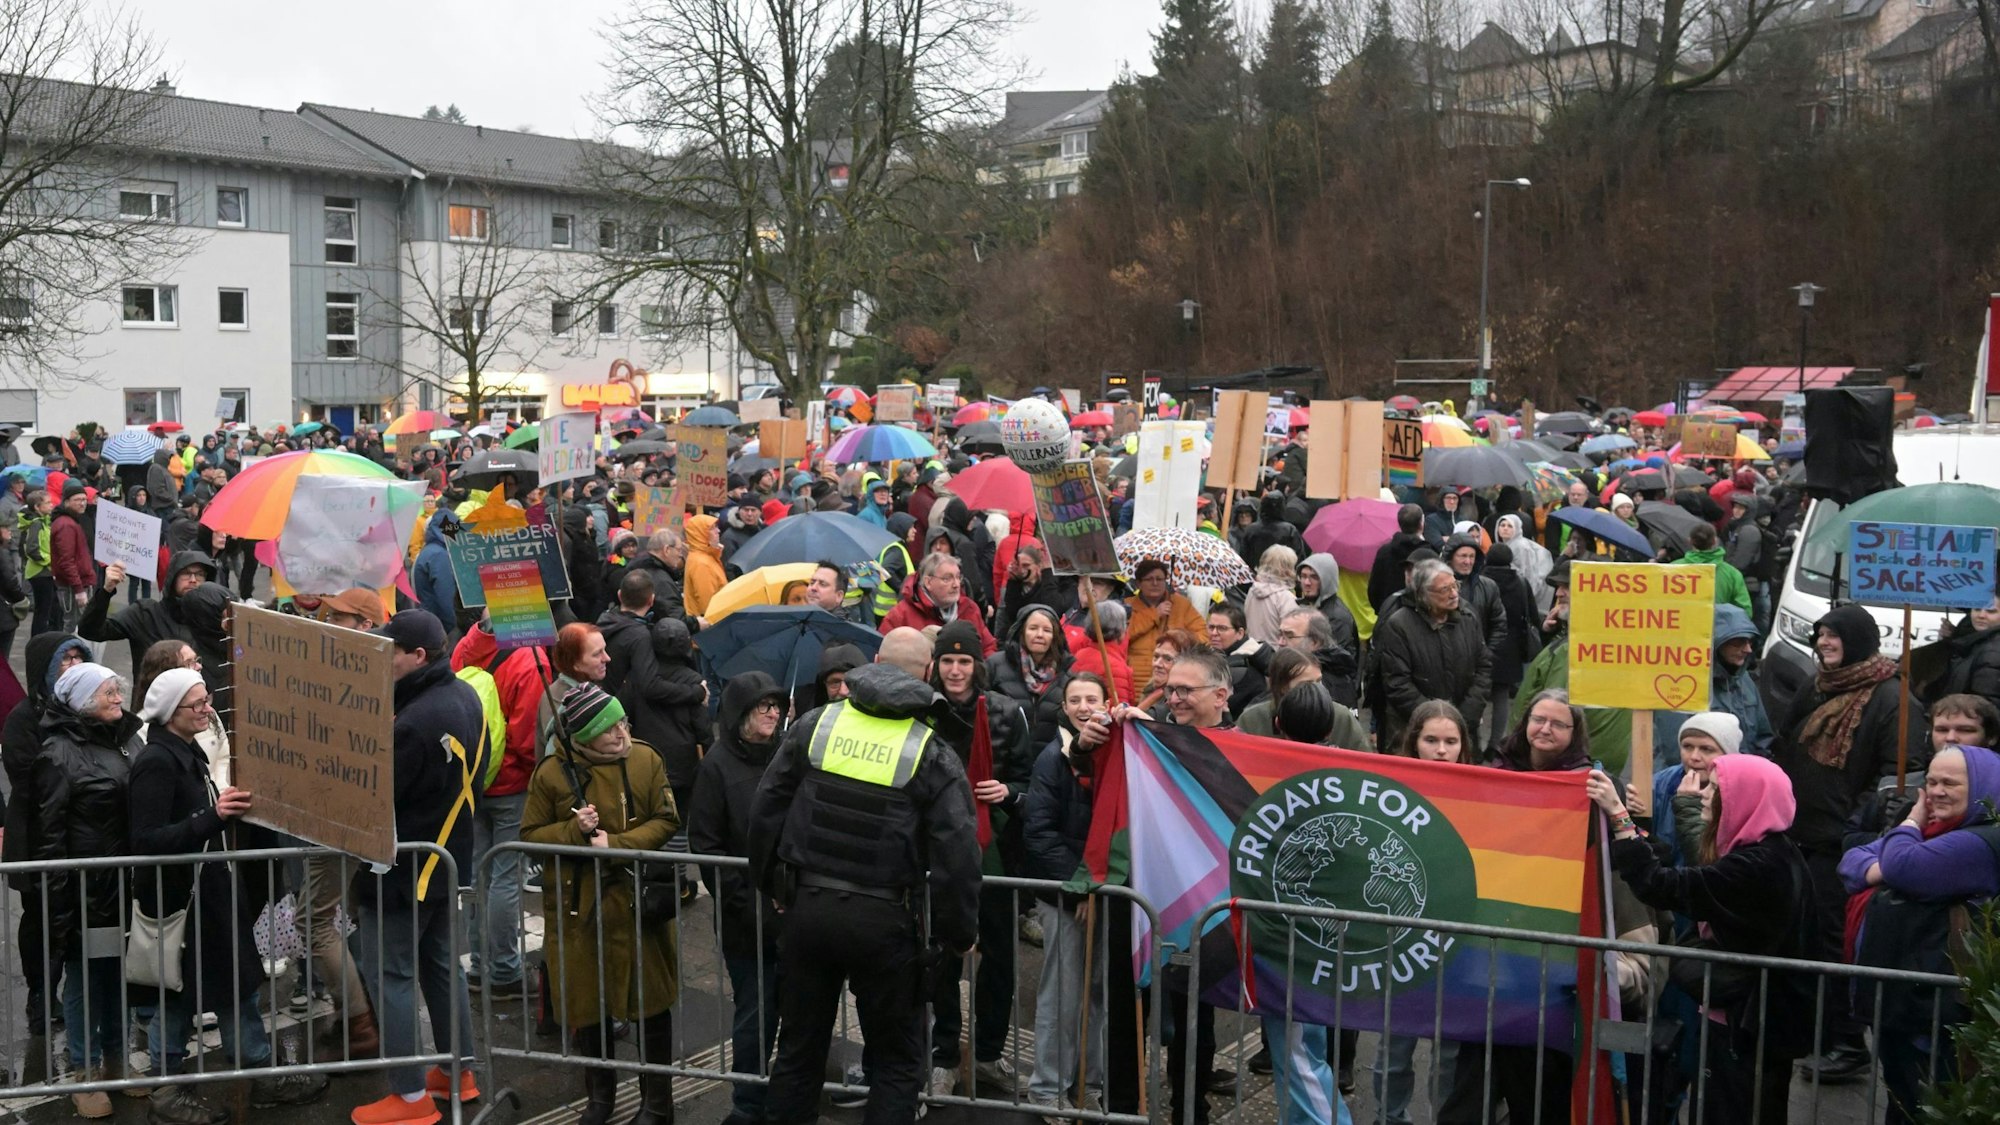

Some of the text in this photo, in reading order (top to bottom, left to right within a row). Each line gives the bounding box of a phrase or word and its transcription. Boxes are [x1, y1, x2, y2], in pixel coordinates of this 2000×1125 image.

[1144, 382, 1161, 406] FCK
[544, 420, 568, 448] NIE
[1393, 424, 1423, 456] AFD
[541, 441, 593, 478] WIEDER!
[678, 443, 701, 458] AFD
[1040, 496, 1100, 522] BUNT
[448, 532, 477, 548] NIE
[1044, 518, 1103, 537] STATT
[1857, 523, 1993, 553] STEH AUF
[124, 542, 153, 558] DINGE
[460, 541, 549, 562] IST JETZT!
[1855, 552, 1983, 570] misch dich ein
[493, 563, 522, 572] WELCOME
[1578, 573, 1702, 594] HASS IST
[1857, 568, 1984, 594] SAGE NEIN
[1604, 608, 1680, 630] KEINE
[247, 621, 369, 675] Euren Hass
[1577, 643, 1710, 668] MEINUNG!
[247, 664, 380, 716] und euren Zorn
[308, 710, 334, 745] Ihr
[348, 728, 386, 757] wo-
[832, 736, 894, 765] POLIZEI
[247, 736, 378, 797] anders sähen!
[1237, 776, 1431, 878] FRIDAYS FOR
[1312, 928, 1455, 992] FUTURE
